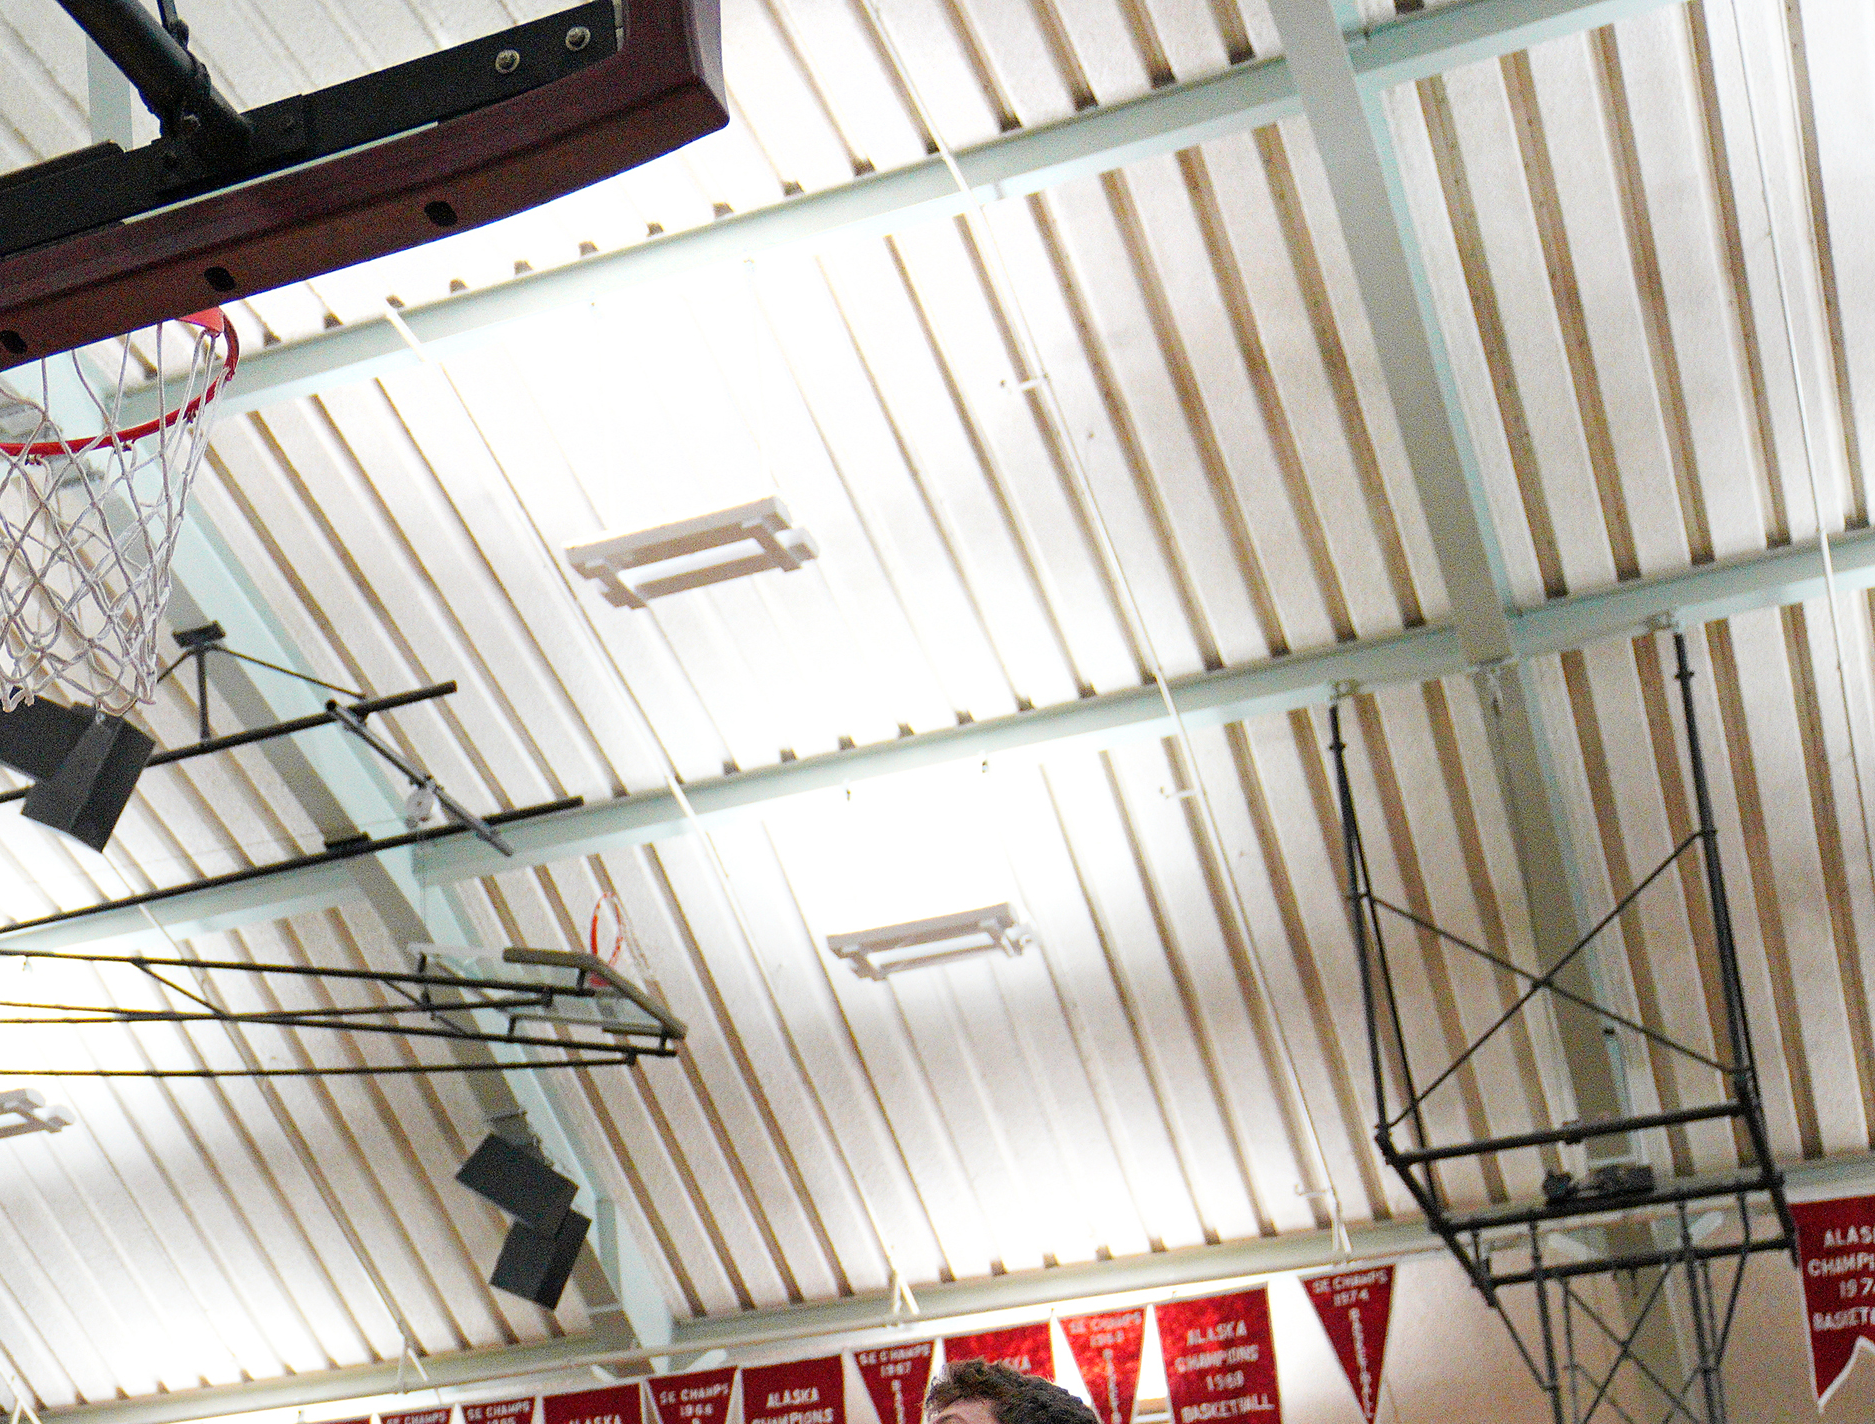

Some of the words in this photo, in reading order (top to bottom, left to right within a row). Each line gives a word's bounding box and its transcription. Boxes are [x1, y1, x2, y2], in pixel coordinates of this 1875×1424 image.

[1824, 1224, 1875, 1248] ALAS
[1333, 1269, 1387, 1290] CHAMPS
[1839, 1277, 1875, 1298] 197
[1187, 1320, 1247, 1346] ALASKA
[1175, 1344, 1259, 1373] CHAMPIONS
[659, 1391, 676, 1404] SE
[680, 1382, 730, 1401] CHAMPS
[766, 1387, 820, 1409] ALASKA
[485, 1400, 530, 1419] CHAMPS
[1182, 1394, 1274, 1424] BASKETBALL
